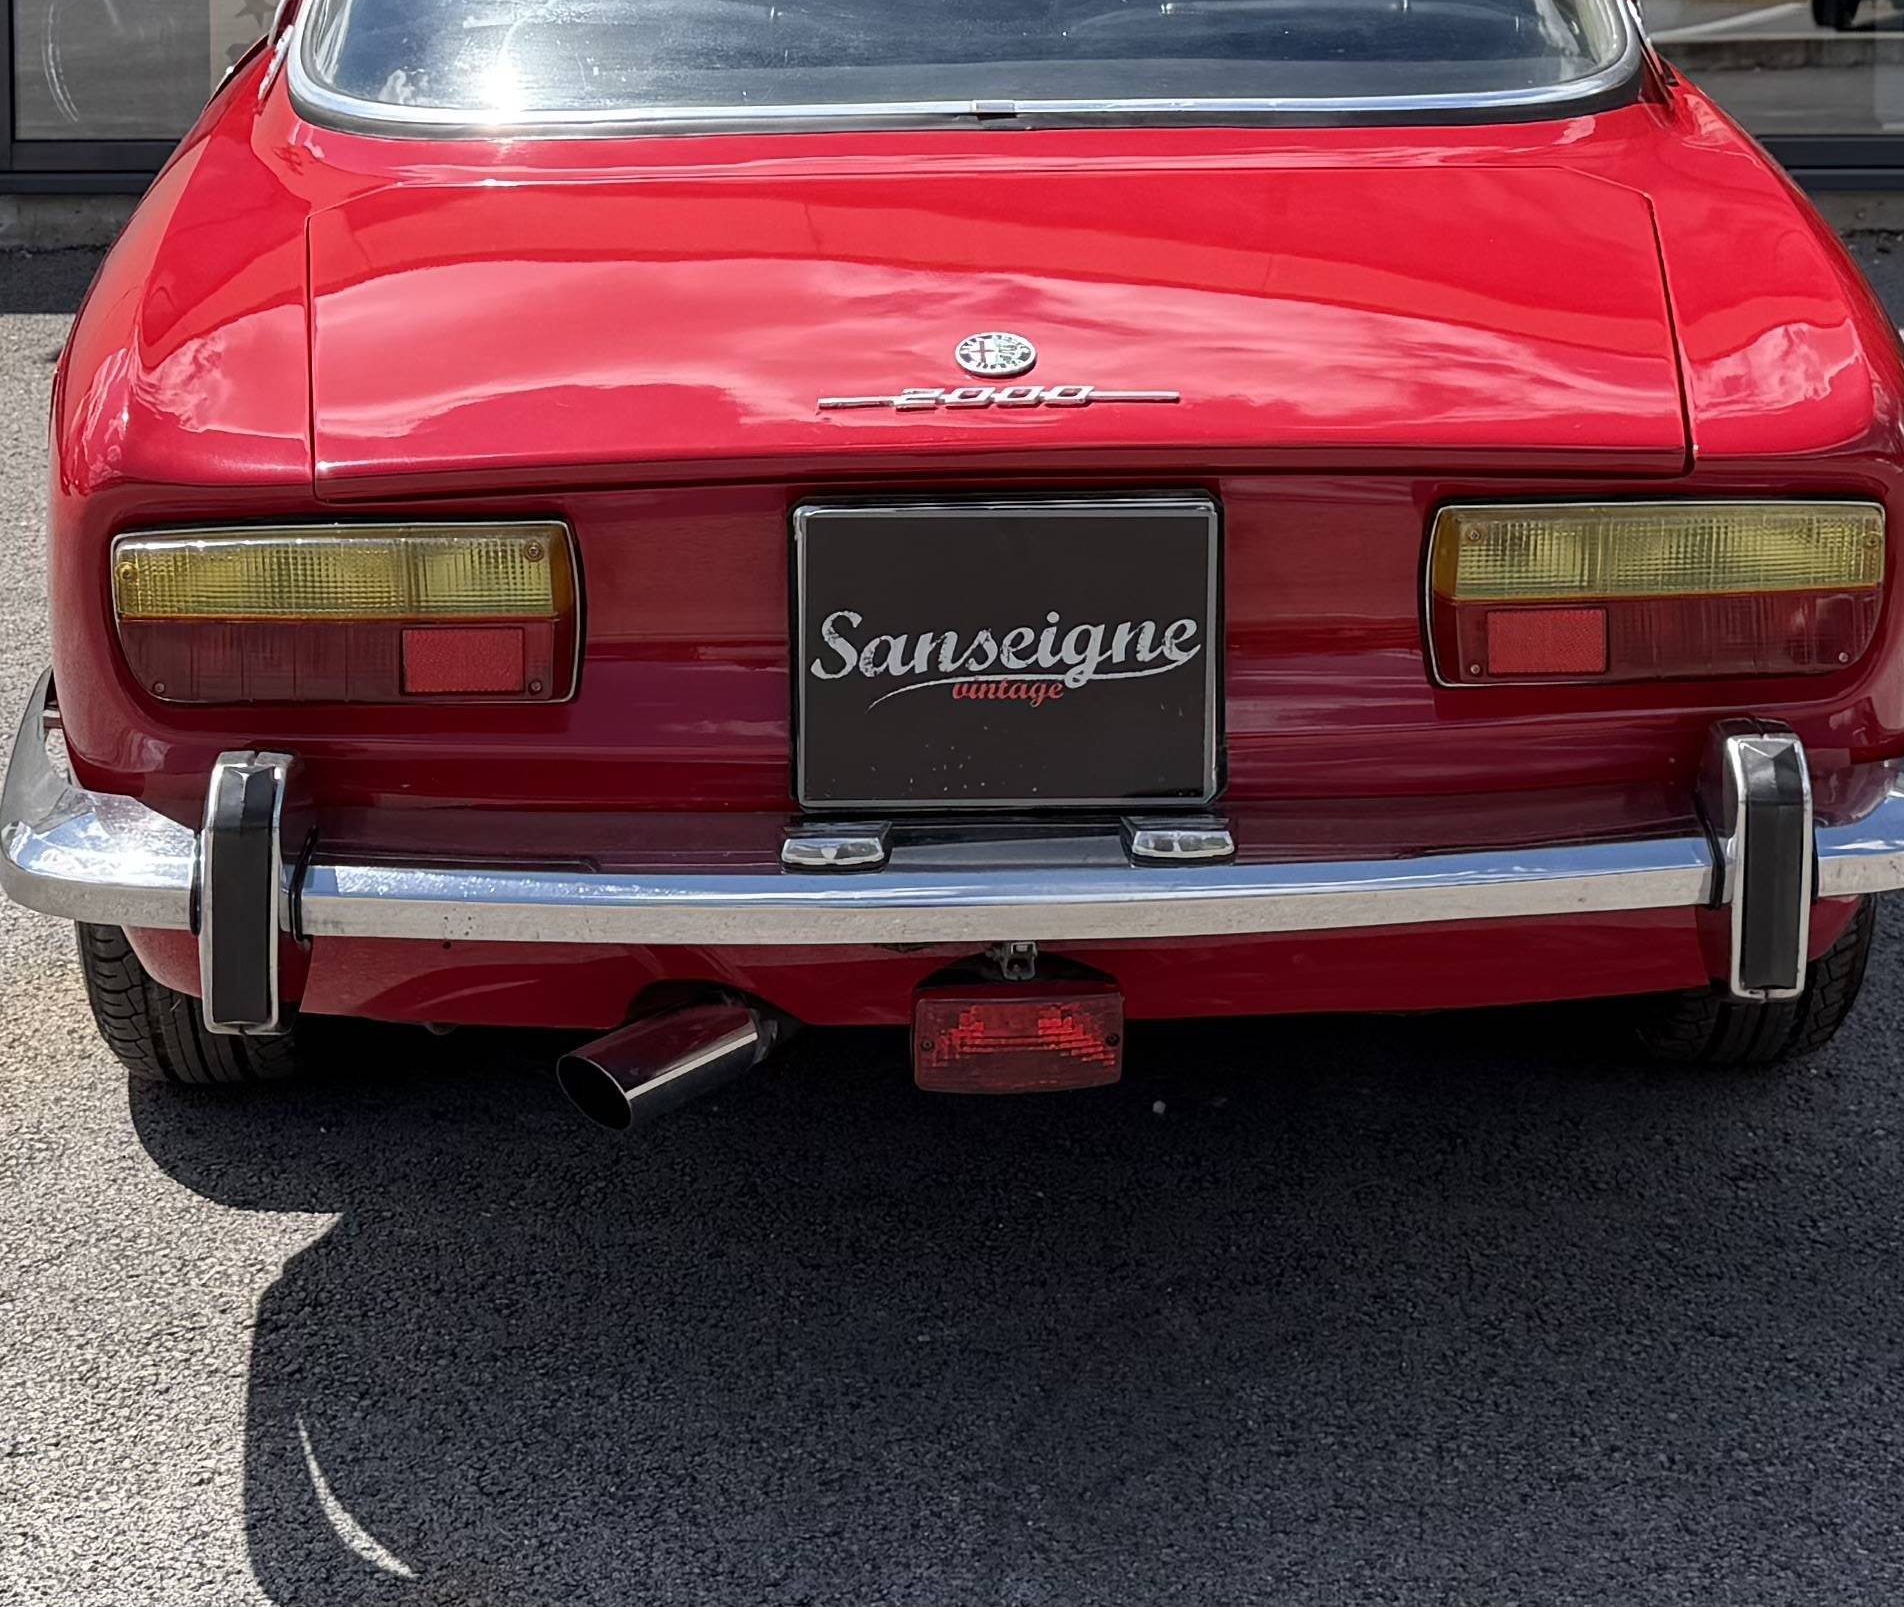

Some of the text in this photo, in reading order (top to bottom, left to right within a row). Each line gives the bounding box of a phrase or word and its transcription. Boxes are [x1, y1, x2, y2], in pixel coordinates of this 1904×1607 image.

[894, 386, 1094, 410] 2000
[811, 610, 1201, 688] Sanseigne
[952, 679, 1065, 707] vintage
